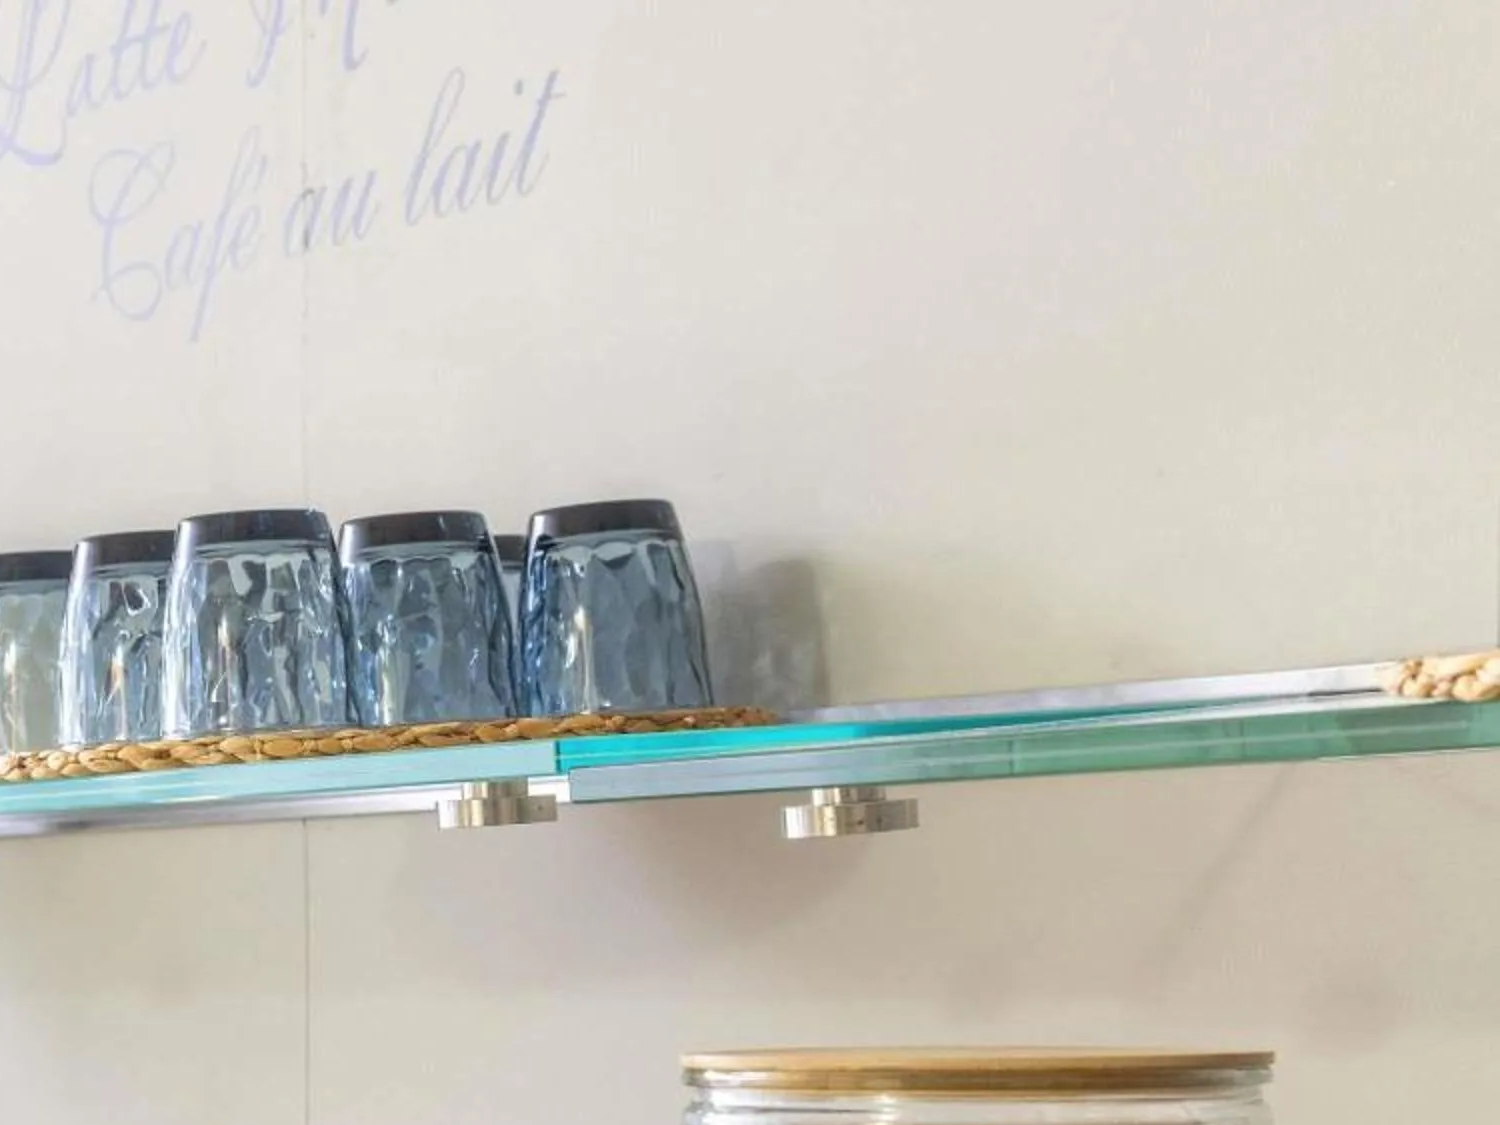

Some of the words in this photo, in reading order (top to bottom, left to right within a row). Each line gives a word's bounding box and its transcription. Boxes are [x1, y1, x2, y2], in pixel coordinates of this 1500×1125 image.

[88, 125, 272, 344] Café
[283, 165, 382, 258] au
[404, 66, 568, 228] lait
